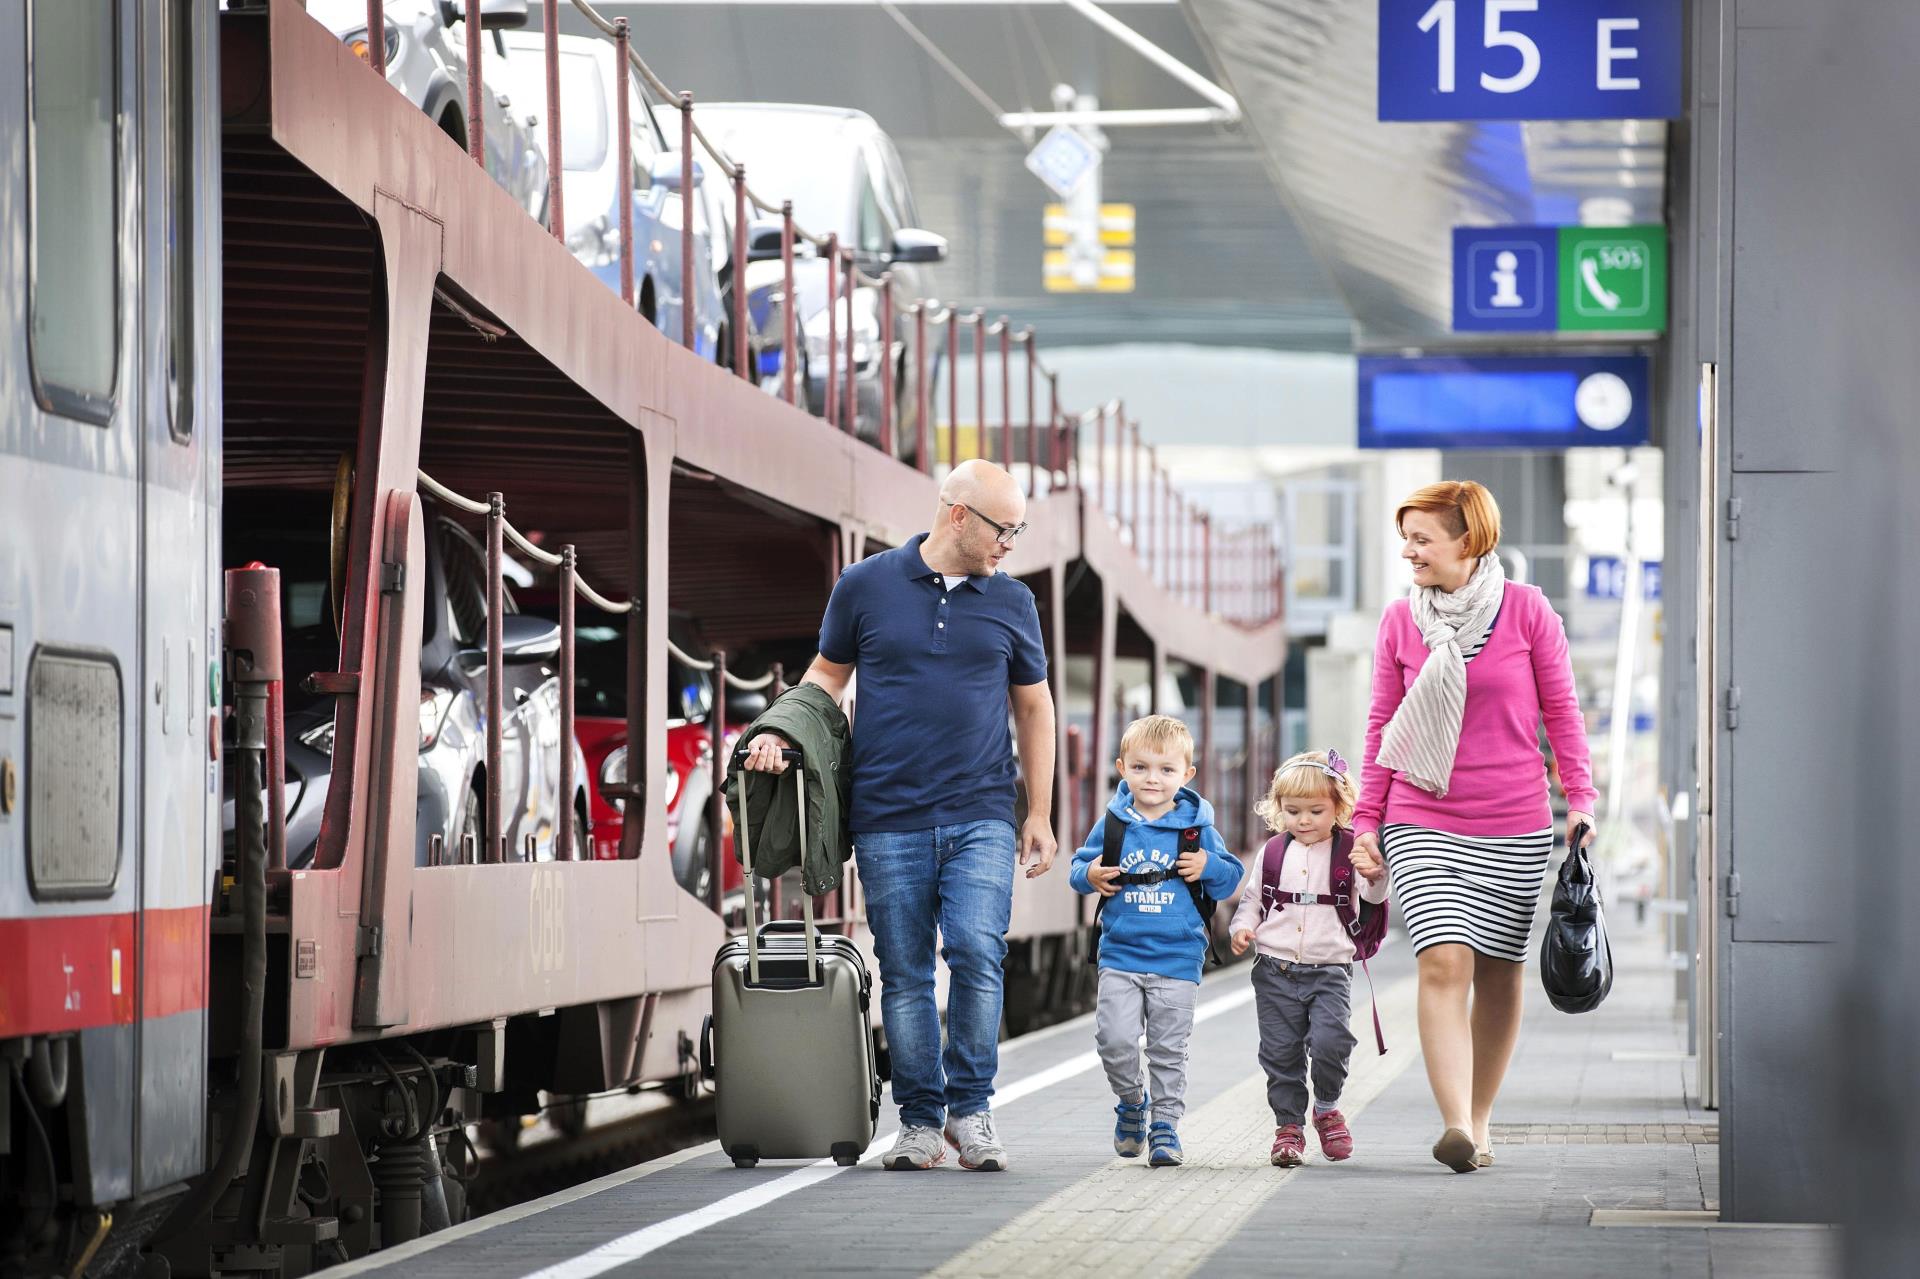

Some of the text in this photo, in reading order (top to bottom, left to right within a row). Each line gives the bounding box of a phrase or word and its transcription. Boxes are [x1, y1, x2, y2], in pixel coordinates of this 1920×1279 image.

[1416, 0, 1641, 93] 15 E
[1599, 246, 1643, 270] SOS
[1124, 891, 1175, 905] STANLEY
